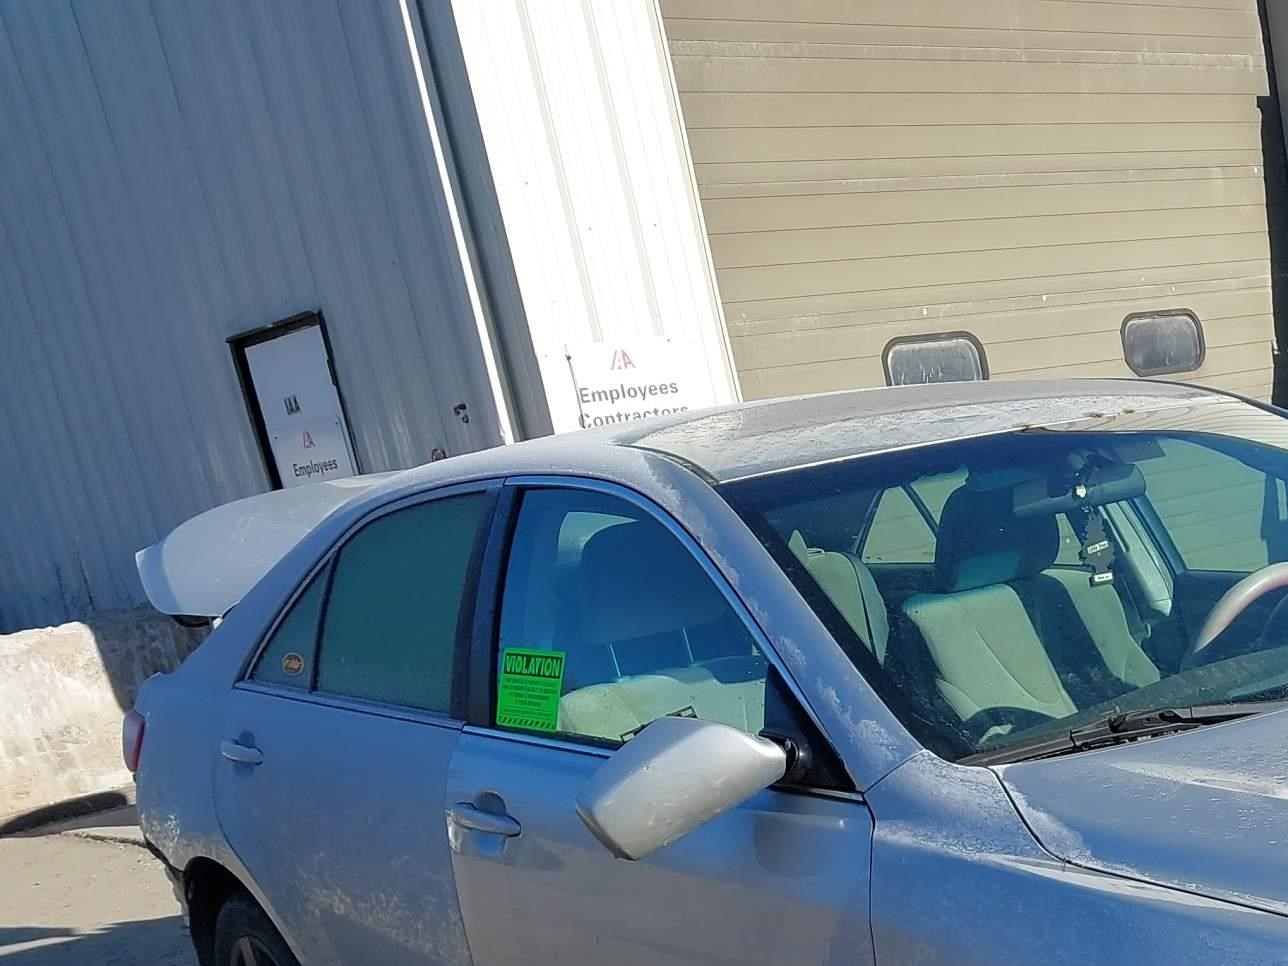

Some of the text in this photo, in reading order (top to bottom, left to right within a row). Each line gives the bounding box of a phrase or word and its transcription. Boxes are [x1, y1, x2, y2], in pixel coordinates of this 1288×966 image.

[579, 382, 679, 405] Employees
[283, 394, 302, 415] IAA
[292, 459, 339, 479] Employees
[506, 655, 561, 677] VIOLATION
